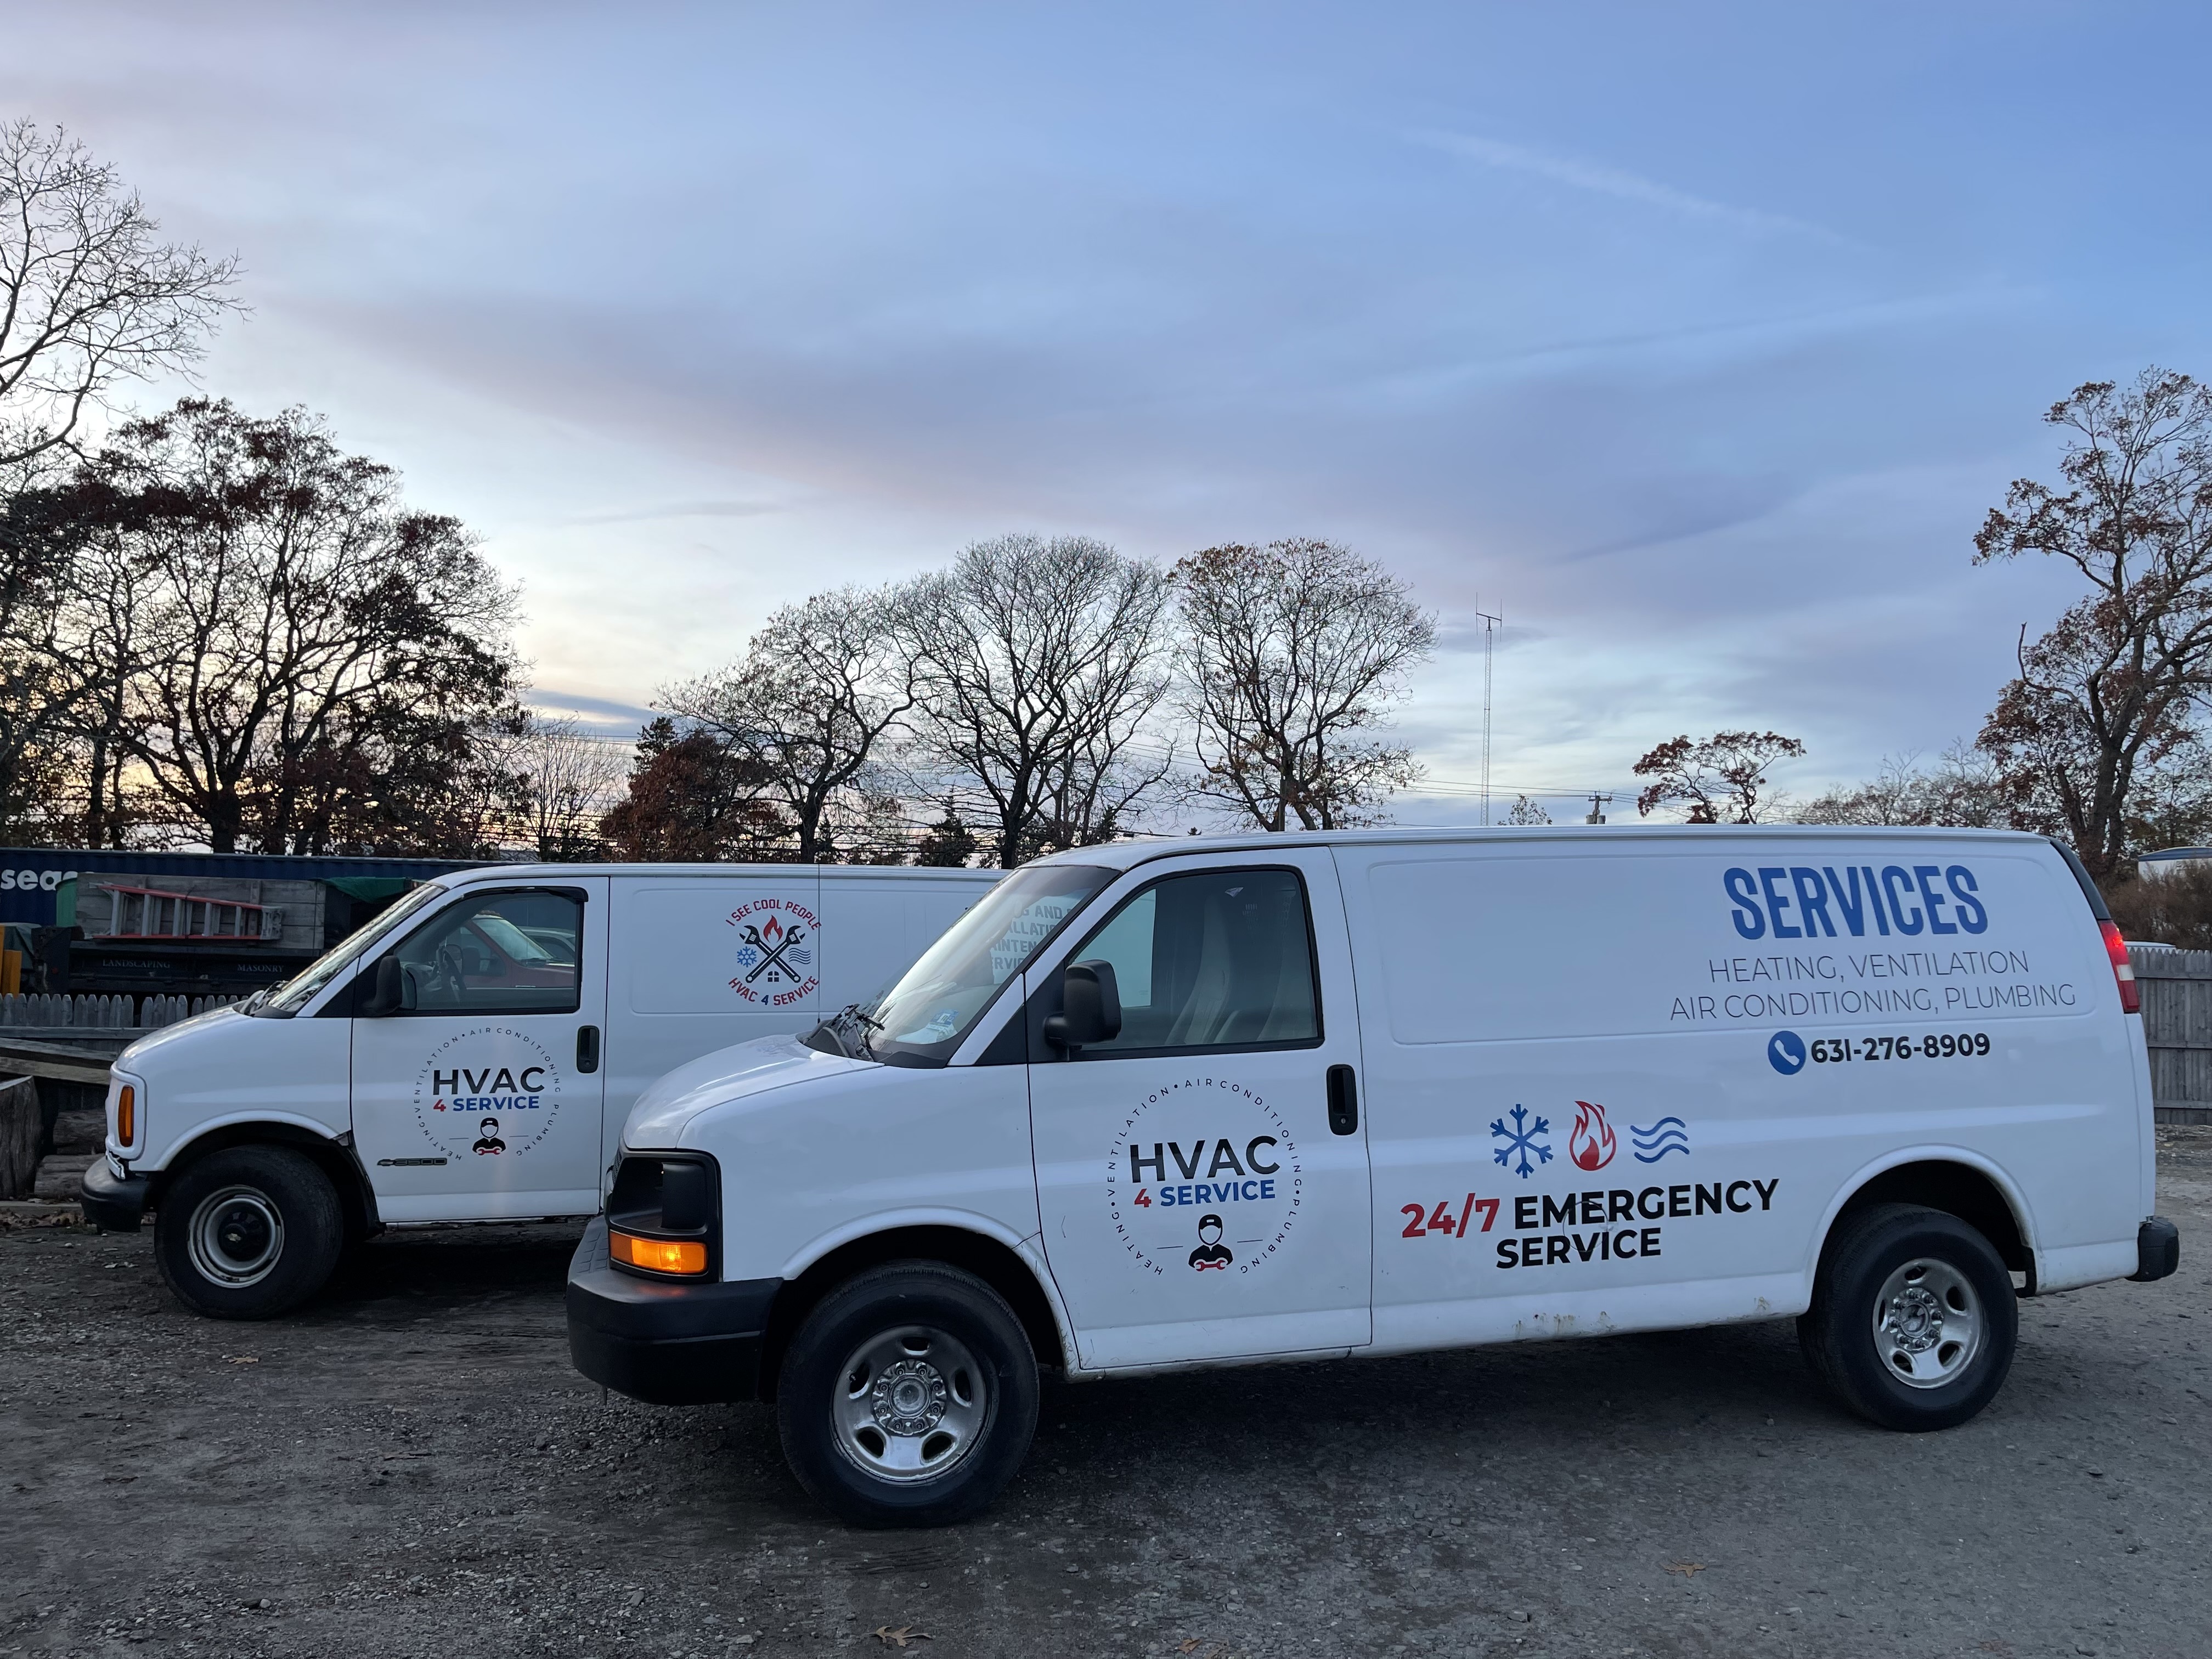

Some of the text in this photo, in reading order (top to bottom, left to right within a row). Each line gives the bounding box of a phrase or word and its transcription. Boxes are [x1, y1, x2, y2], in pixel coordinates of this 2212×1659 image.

[731, 904, 752, 921] SEE
[753, 899, 781, 911] COOL
[785, 901, 822, 930] PEOPLE
[1035, 905, 1063, 919] AND
[1724, 865, 1988, 940] SERVICES
[103, 959, 170, 969] LANDSCAPING
[237, 964, 284, 973] MASONRY
[1709, 951, 2029, 983] HEATING, VENTILATION
[729, 976, 819, 1006] HVAC 4 SERVICE
[1670, 984, 2075, 1020] AIR CONDITIONING, PLUMBING
[1811, 1032, 1990, 1063] 631-276-8909
[414, 1036, 458, 1113] VENTILATION
[433, 1066, 545, 1095] HVAC
[433, 1096, 539, 1112] 4 SERVICE
[419, 1122, 462, 1160] HEATING
[516, 1104, 559, 1156] PLUMBING
[1107, 1087, 1169, 1197] VENTILATION
[1130, 1136, 1280, 1183] HVAC
[1134, 1180, 1276, 1207] 4 SERVICE
[1400, 1178, 1780, 1238] 24/7 EMERGENCY
[1111, 1212, 1163, 1275] HEATING
[1240, 1199, 1300, 1273] PLUMBING
[1496, 1227, 1661, 1268] SERVICE
